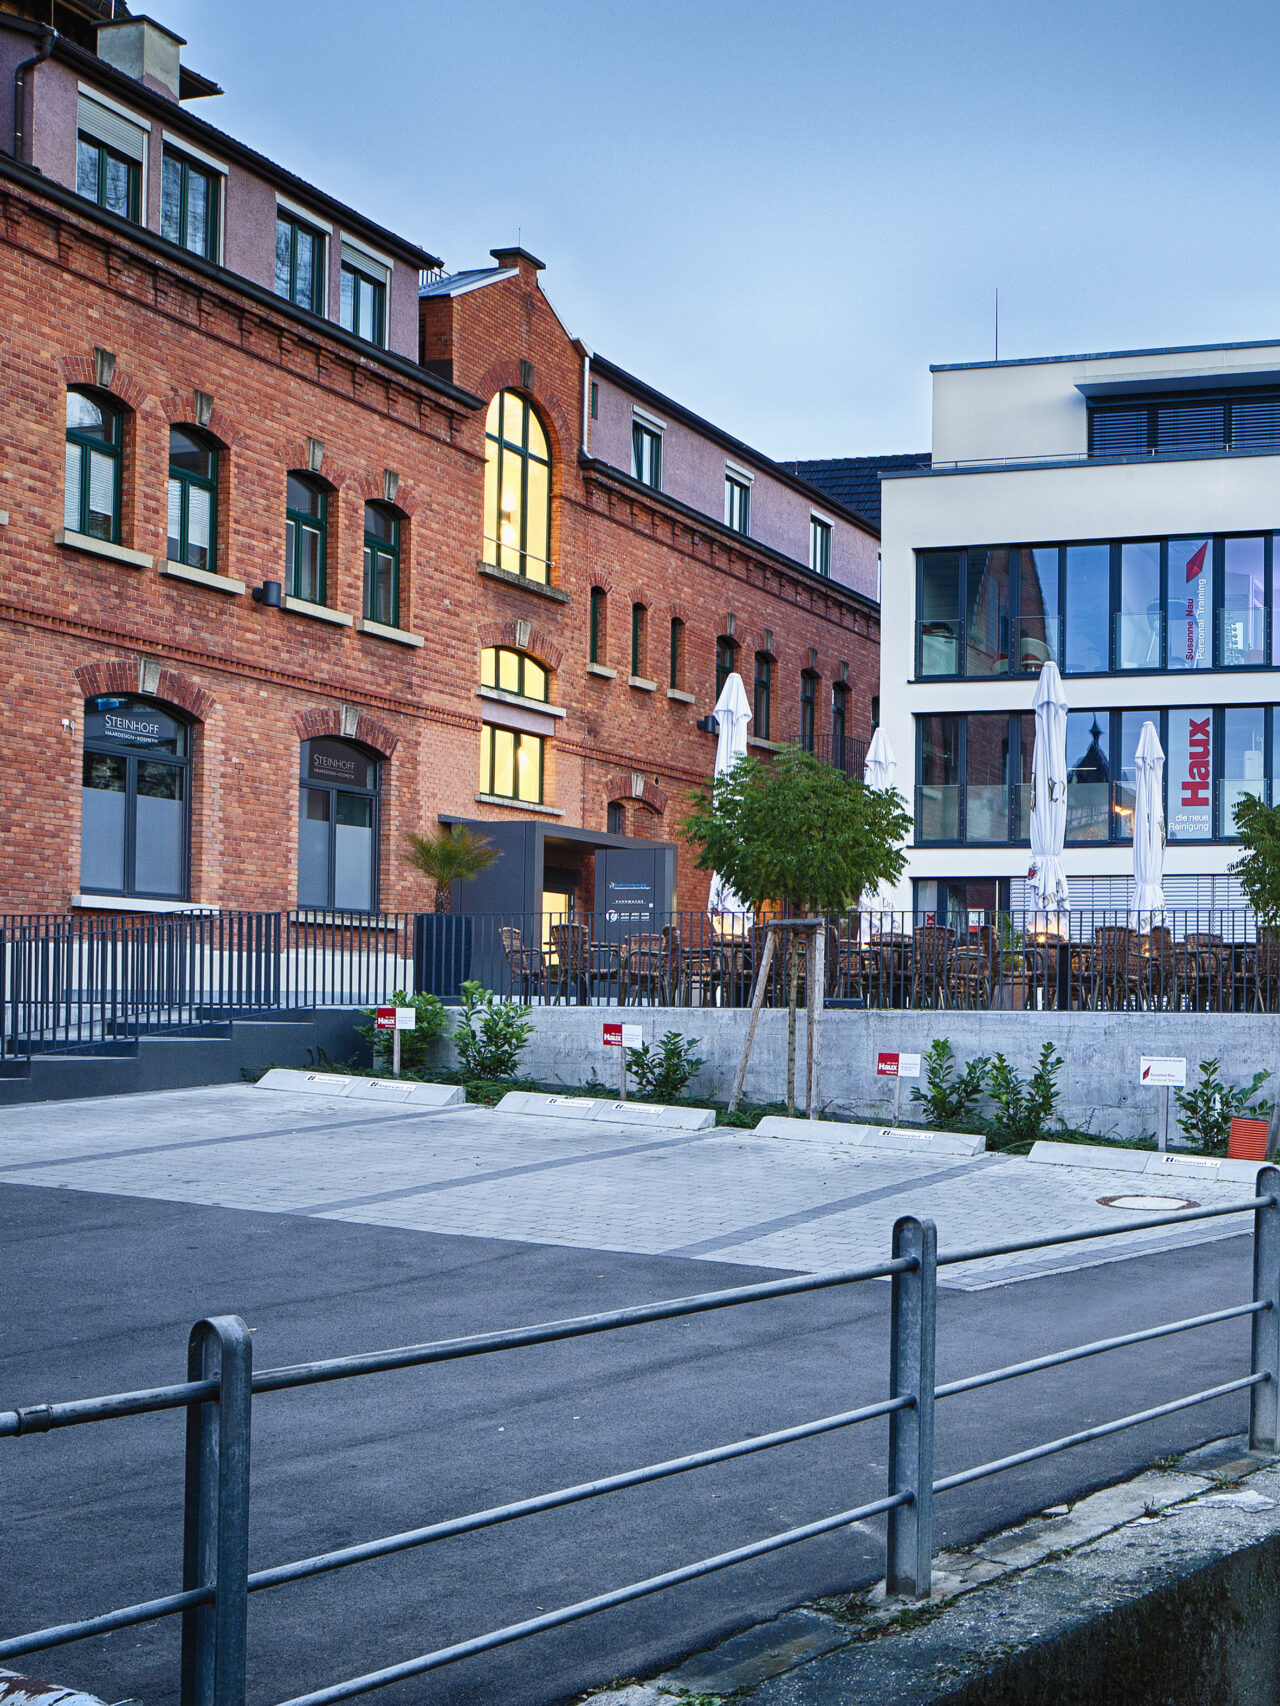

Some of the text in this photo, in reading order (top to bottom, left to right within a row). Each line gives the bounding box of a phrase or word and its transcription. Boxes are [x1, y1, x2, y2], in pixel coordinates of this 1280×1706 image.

[1197, 579, 1207, 660] Personal Training
[1185, 598, 1194, 660] Susanne Nau
[105, 714, 159, 735] STEINHOFF
[313, 753, 356, 771] STEINHOFF
[1181, 716, 1210, 807] Haux
[1175, 813, 1209, 822] die neue
[1168, 822, 1209, 832] Reinigung
[377, 1017, 396, 1025] Haux
[603, 1033, 622, 1042] Haux
[878, 1062, 898, 1071] Haux
